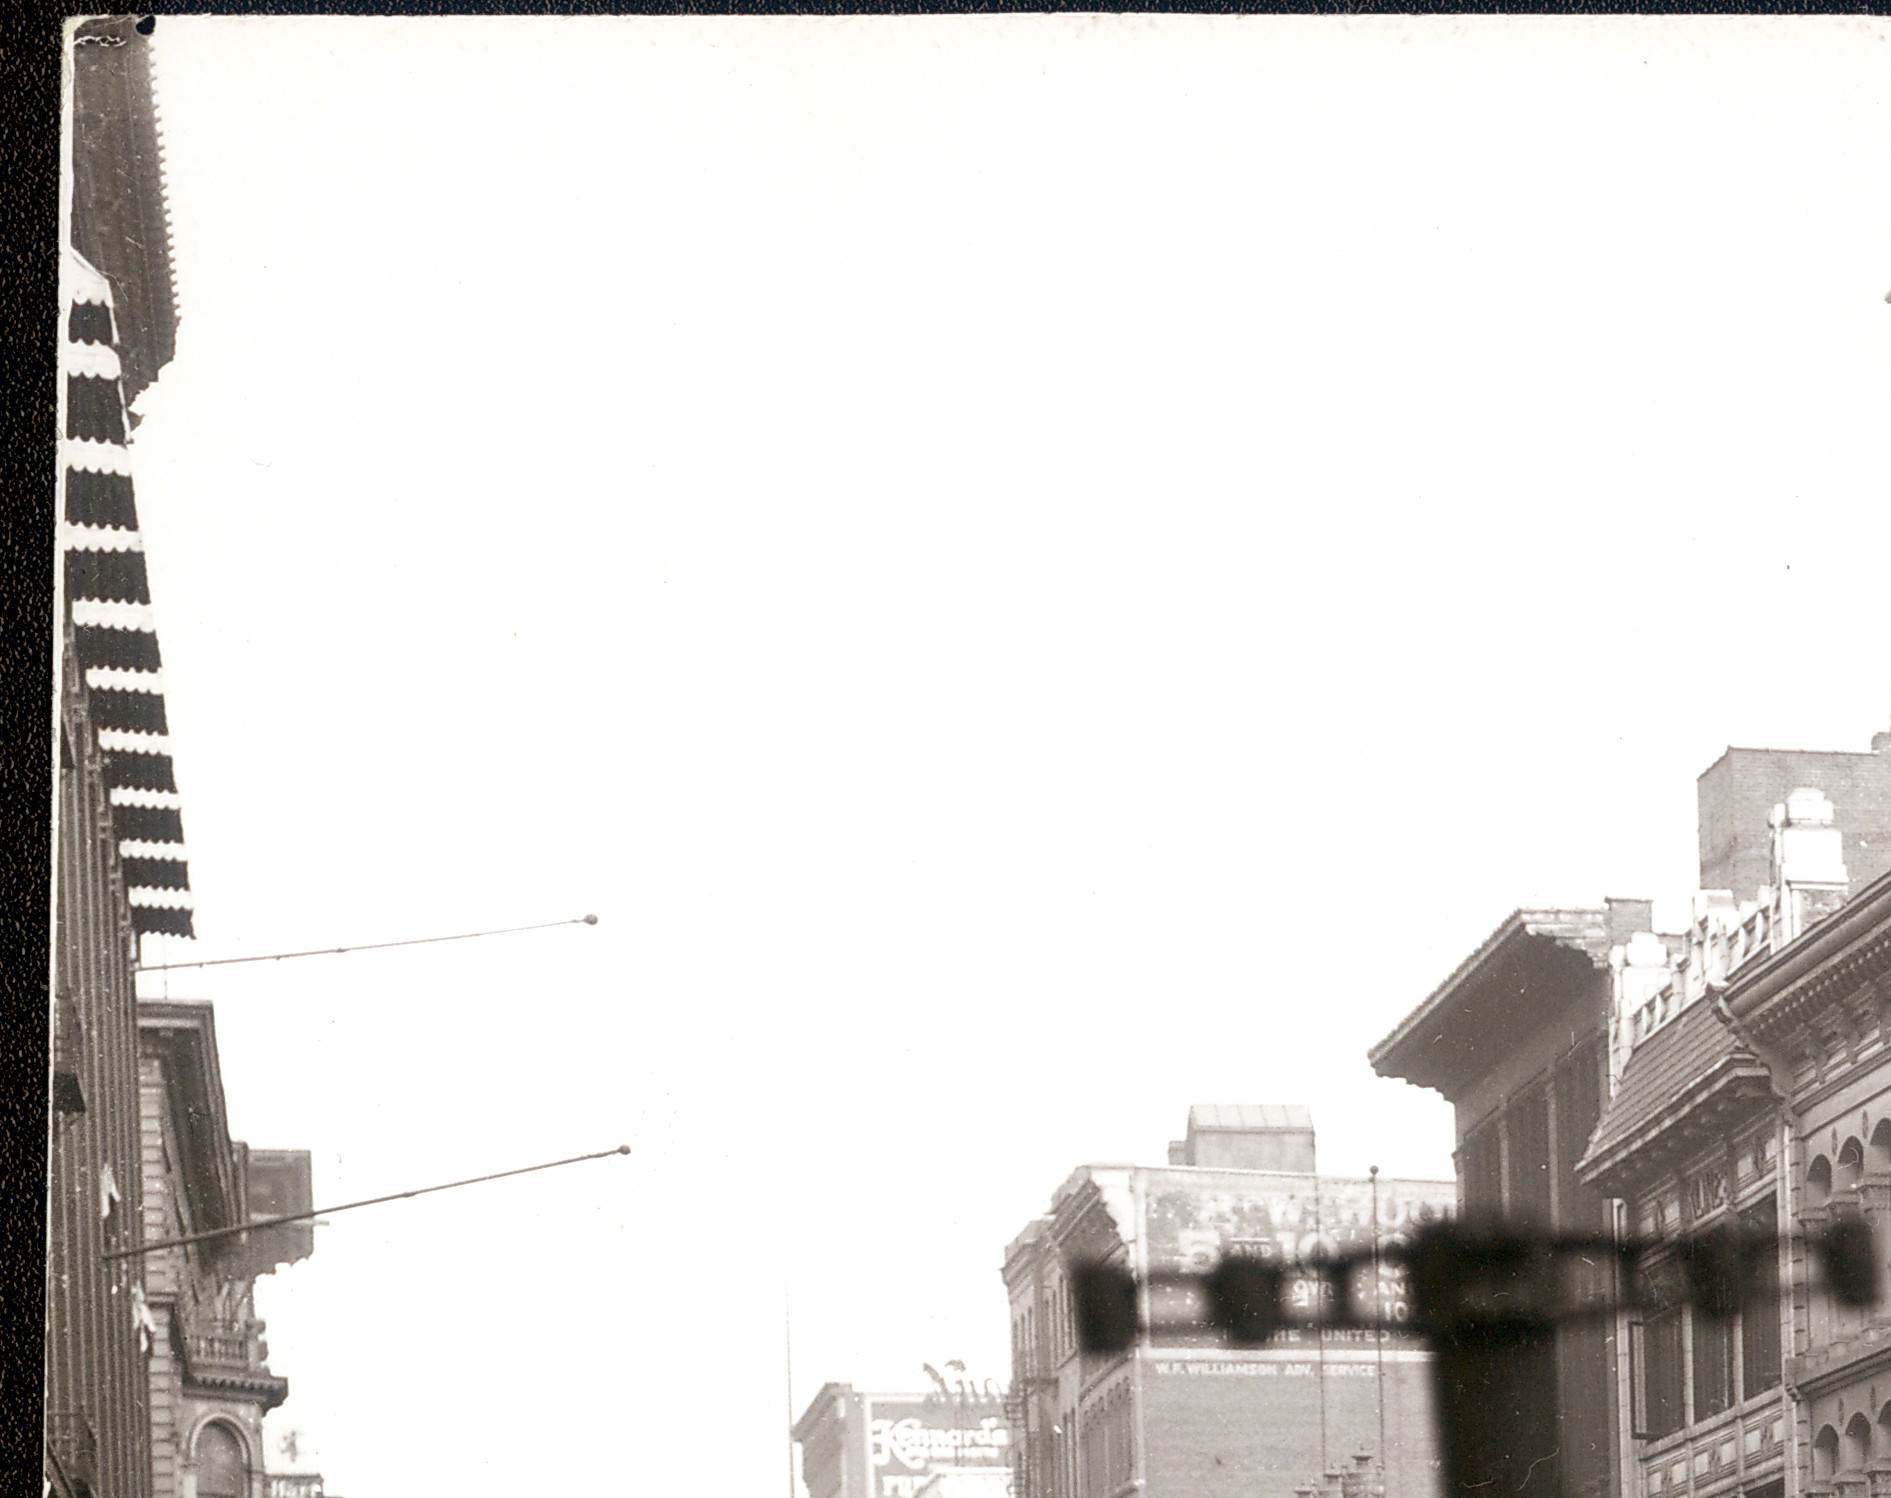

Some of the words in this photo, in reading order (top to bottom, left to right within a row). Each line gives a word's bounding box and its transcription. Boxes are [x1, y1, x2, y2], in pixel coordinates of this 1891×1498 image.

[1321, 1328, 1391, 1342] UNITED
[1186, 1363, 1278, 1377] WILLIAMSON
[1322, 1363, 1377, 1377] SERVICE
